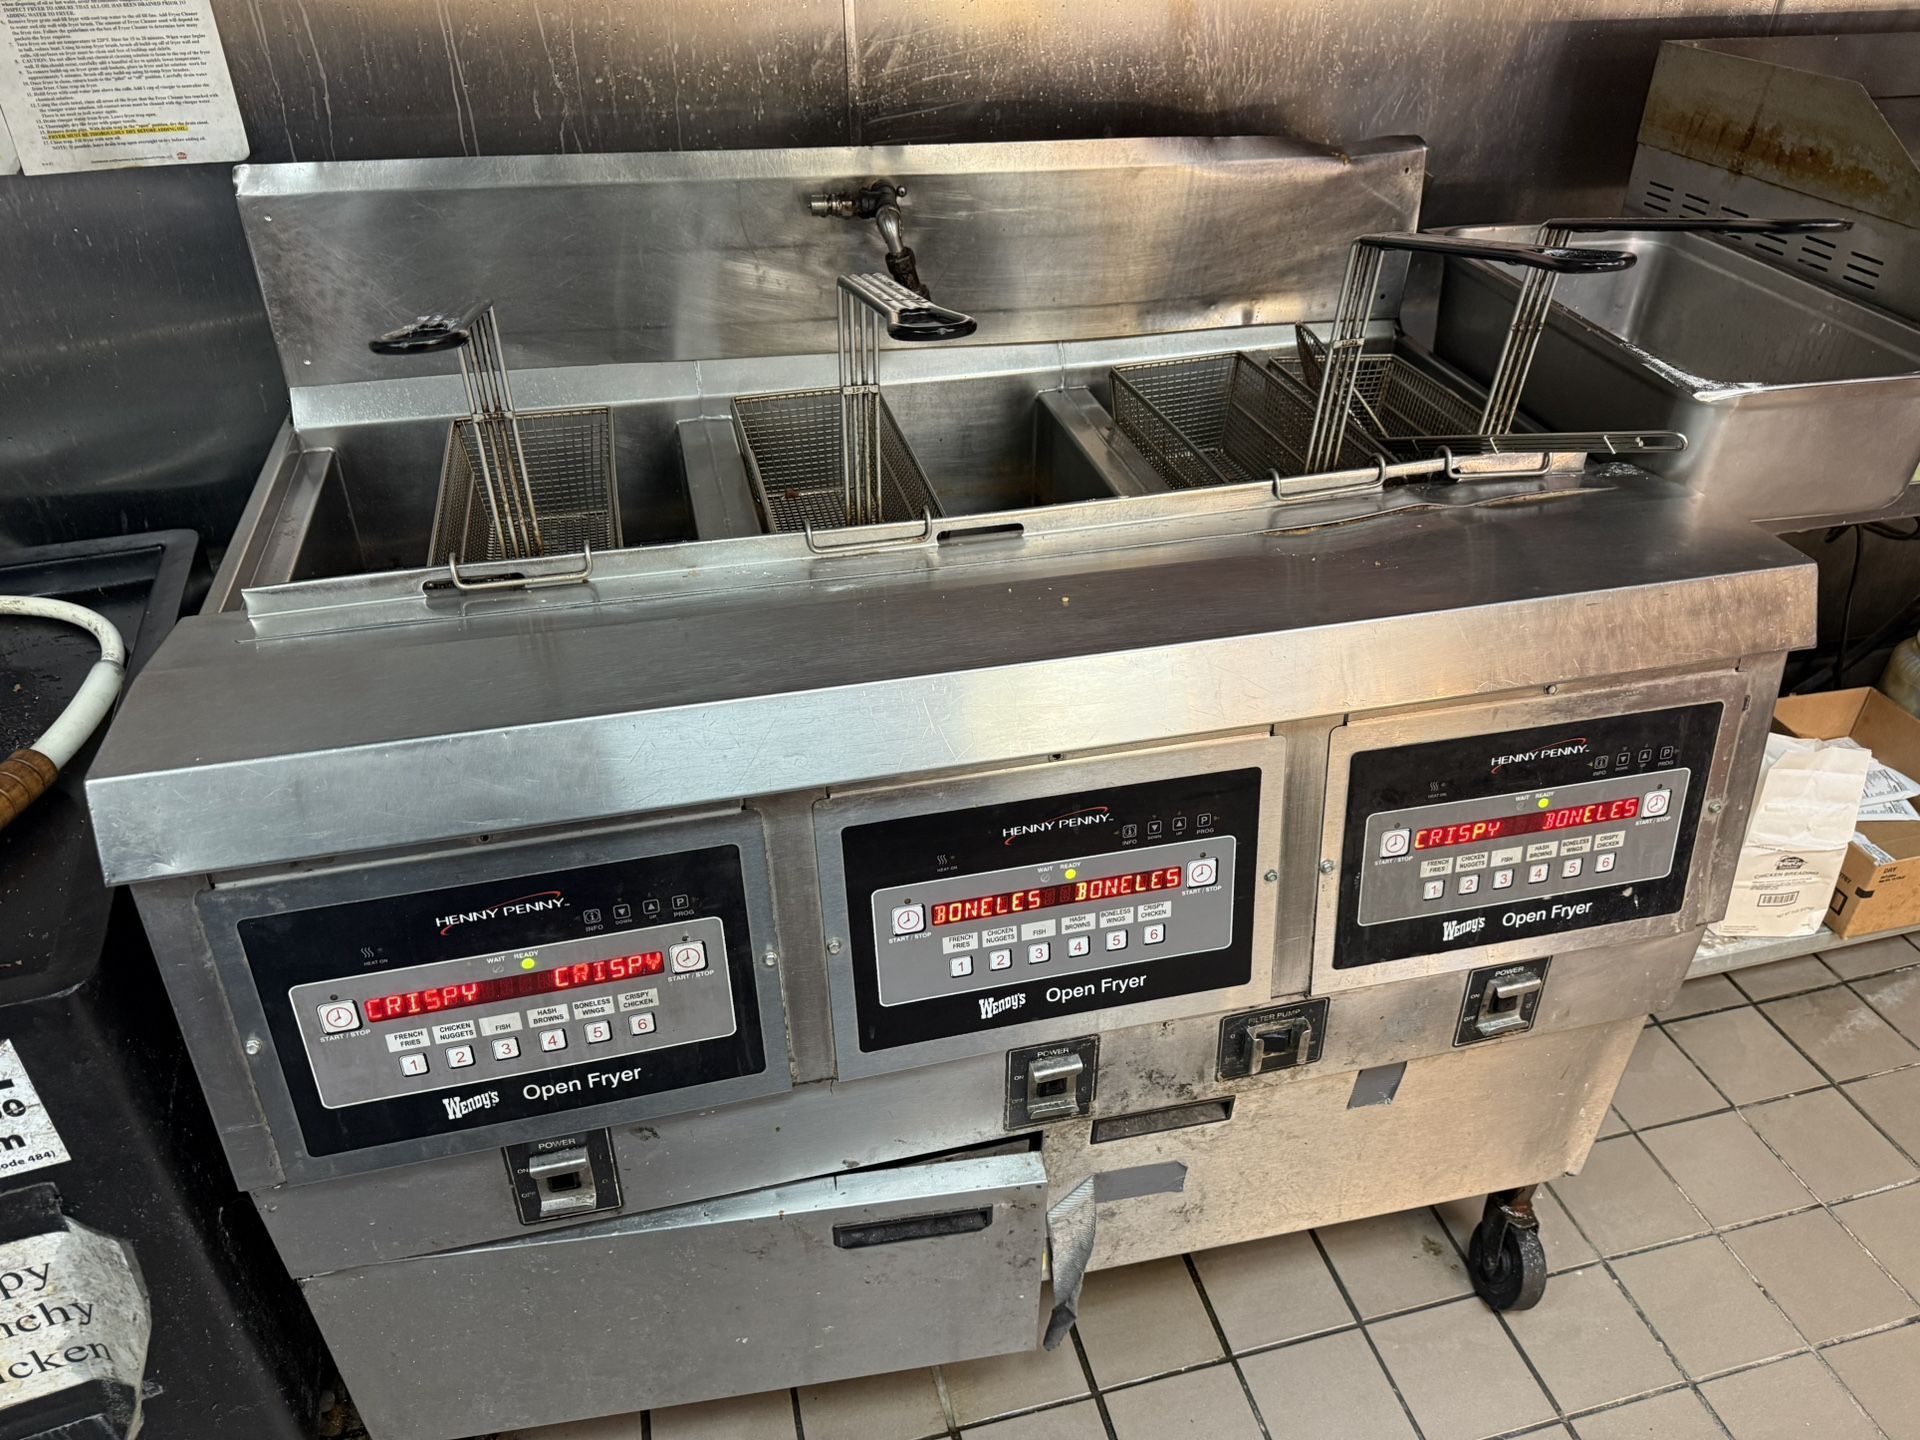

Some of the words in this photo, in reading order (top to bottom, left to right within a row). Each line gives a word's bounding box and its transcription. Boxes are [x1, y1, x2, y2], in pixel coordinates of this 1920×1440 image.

[1491, 751, 1538, 766] HENNY
[1541, 744, 1587, 759] PENNY
[1002, 821, 1055, 837] HENNY
[1059, 812, 1110, 829] PENNY
[1414, 821, 1500, 849] CRISPY
[1542, 798, 1638, 830] BONELES
[1562, 838, 1590, 847] BONELESS
[1596, 841, 1620, 849] CHICKEN
[1461, 854, 1485, 862] CHICKEN
[1530, 850, 1553, 859] BROWNS
[1037, 865, 1053, 873] WAIT
[1060, 861, 1081, 869] READY
[1374, 858, 1393, 866] START
[1427, 859, 1449, 867] FRENCH
[1460, 860, 1485, 869] NUGGETS
[1568, 862, 1577, 873] 5
[1602, 857, 1610, 868] 6
[1500, 873, 1508, 884] 3
[1534, 868, 1542, 878] 4
[1206, 885, 1222, 893] STOP
[1431, 885, 1437, 895] 1
[1465, 879, 1474, 890] 2
[934, 890, 1040, 925] BONELES
[1075, 868, 1179, 901] BONELES
[436, 908, 499, 928] HENNY
[503, 897, 564, 917] PENNY
[1143, 903, 1165, 911] CRISPY
[673, 909, 694, 918] PROG
[1100, 908, 1131, 918] BONELESS
[1140, 909, 1167, 919] CHICKEN
[1502, 909, 1547, 928] Open
[1551, 901, 1593, 920] Fryer
[615, 918, 633, 926] DOWN
[1064, 921, 1091, 930] BROWNS
[1106, 916, 1126, 924] WINGS
[585, 924, 604, 932] INFO
[987, 927, 1014, 936] CHICKEN
[1033, 928, 1047, 936] FISH
[888, 935, 909, 944] START
[914, 931, 932, 940] STOP
[948, 934, 974, 943] FRENCH
[986, 934, 1015, 943] NUGGETS
[1150, 929, 1158, 940] 6
[952, 941, 971, 950] FRIES
[1112, 935, 1121, 946] 5
[1074, 941, 1082, 952] 4
[486, 955, 506, 964] WAIT
[513, 951, 539, 960] READY
[1035, 947, 1044, 959] 3
[996, 954, 1005, 966] 2
[958, 961, 965, 972] 1
[1494, 966, 1525, 977] POWER
[667, 974, 690, 983] START
[695, 969, 715, 978] STOP
[367, 983, 477, 1019] CRISPY
[555, 951, 661, 987] CRISPY
[1046, 983, 1095, 1004] Open
[1101, 975, 1147, 994] Fryer
[624, 991, 649, 1001] CRISPY
[574, 998, 611, 1010] BONELESS
[623, 998, 653, 1009] CHICKEN
[537, 1007, 557, 1016] HASH
[582, 1007, 605, 1016] WINGS
[1248, 1013, 1276, 1025] FILTER
[1277, 1008, 1301, 1018] PUMP
[533, 1014, 565, 1025] BROWNS
[637, 1018, 647, 1030] 6
[439, 1022, 471, 1033] CHICKEN
[495, 1023, 512, 1031] FISH
[320, 1034, 345, 1043] START
[350, 1029, 371, 1038] STOP
[394, 1030, 424, 1041] FRENCH
[440, 1030, 474, 1041] NUGGETS
[593, 1027, 603, 1039] 5
[400, 1039, 421, 1048] FRIES
[548, 1035, 557, 1046] 4
[501, 1043, 512, 1055] 3
[1037, 1047, 1069, 1058] POWER
[456, 1051, 466, 1063] 2
[410, 1059, 418, 1071] 1
[523, 1079, 582, 1101] Open
[587, 1067, 642, 1088] Fryer
[538, 1138, 576, 1150] POWER
[0, 1158, 25, 1171] ode
